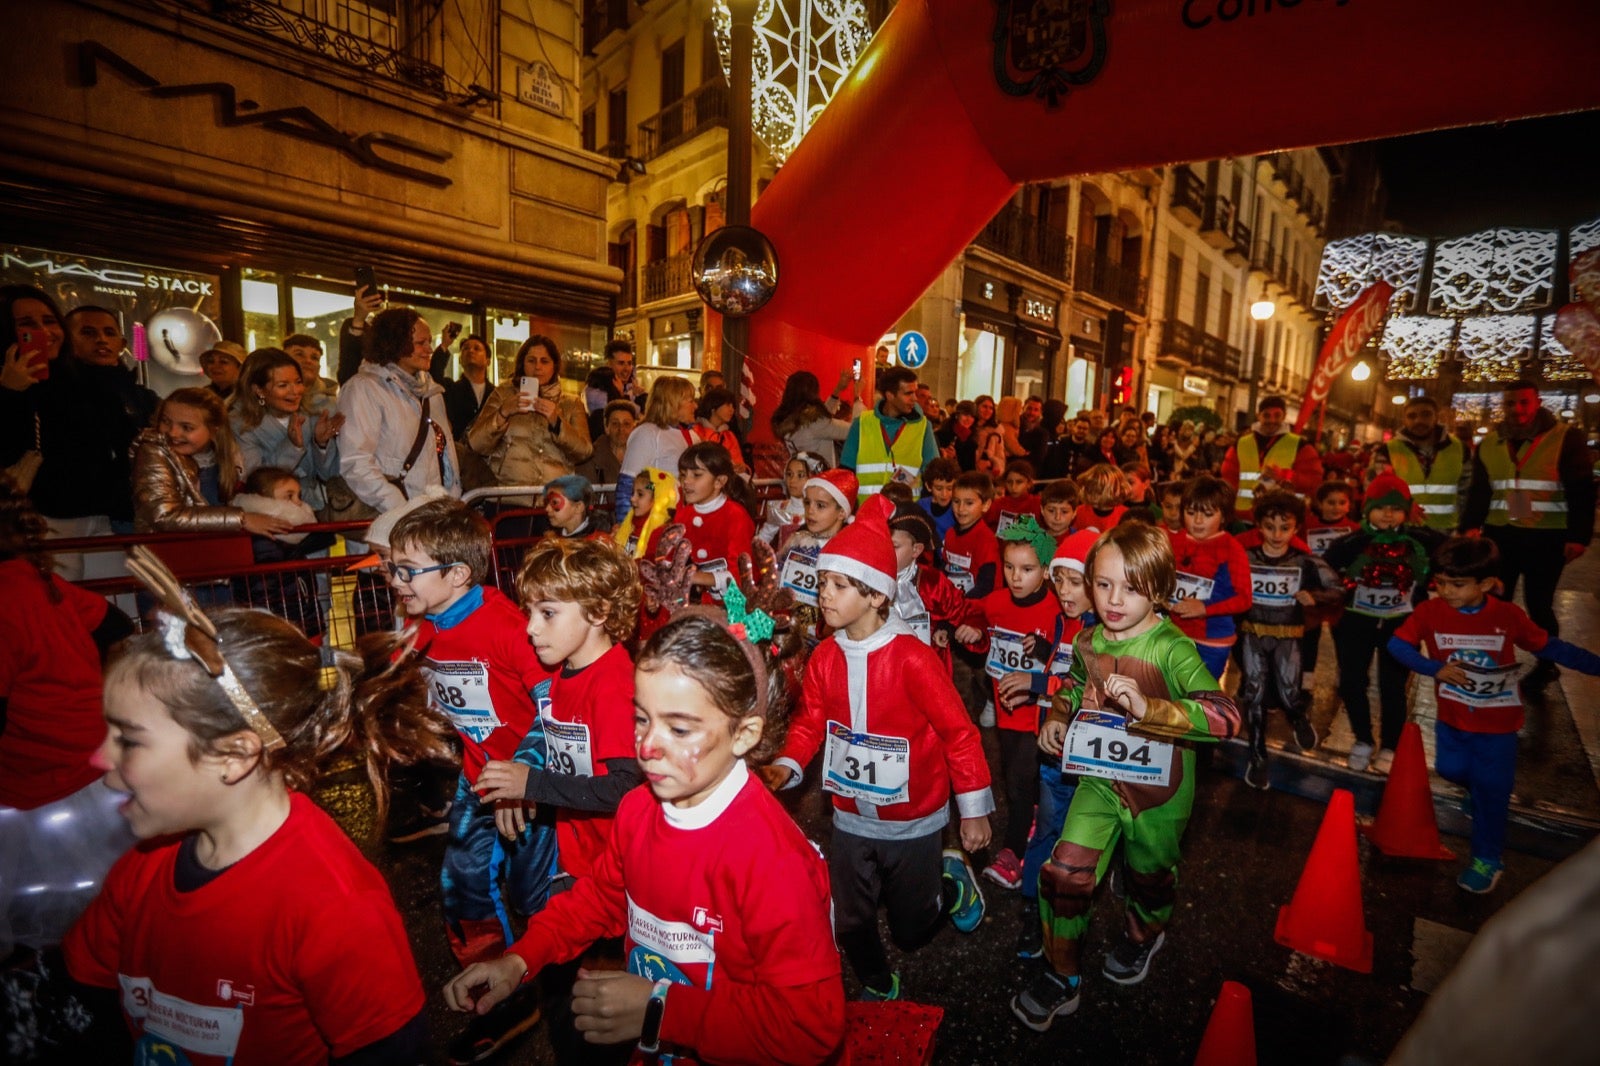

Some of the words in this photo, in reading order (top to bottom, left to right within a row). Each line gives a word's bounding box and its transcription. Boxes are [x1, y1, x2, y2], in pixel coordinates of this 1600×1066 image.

[94, 286, 137, 297] MASCARA
[147, 275, 213, 296] STACK
[791, 570, 819, 591] 29
[1253, 580, 1289, 595] 203
[1170, 587, 1198, 601] 04
[435, 681, 467, 708] 88
[1087, 736, 1152, 766] 194
[844, 756, 877, 785] 31
[658, 928, 702, 942] NOCTURNA
